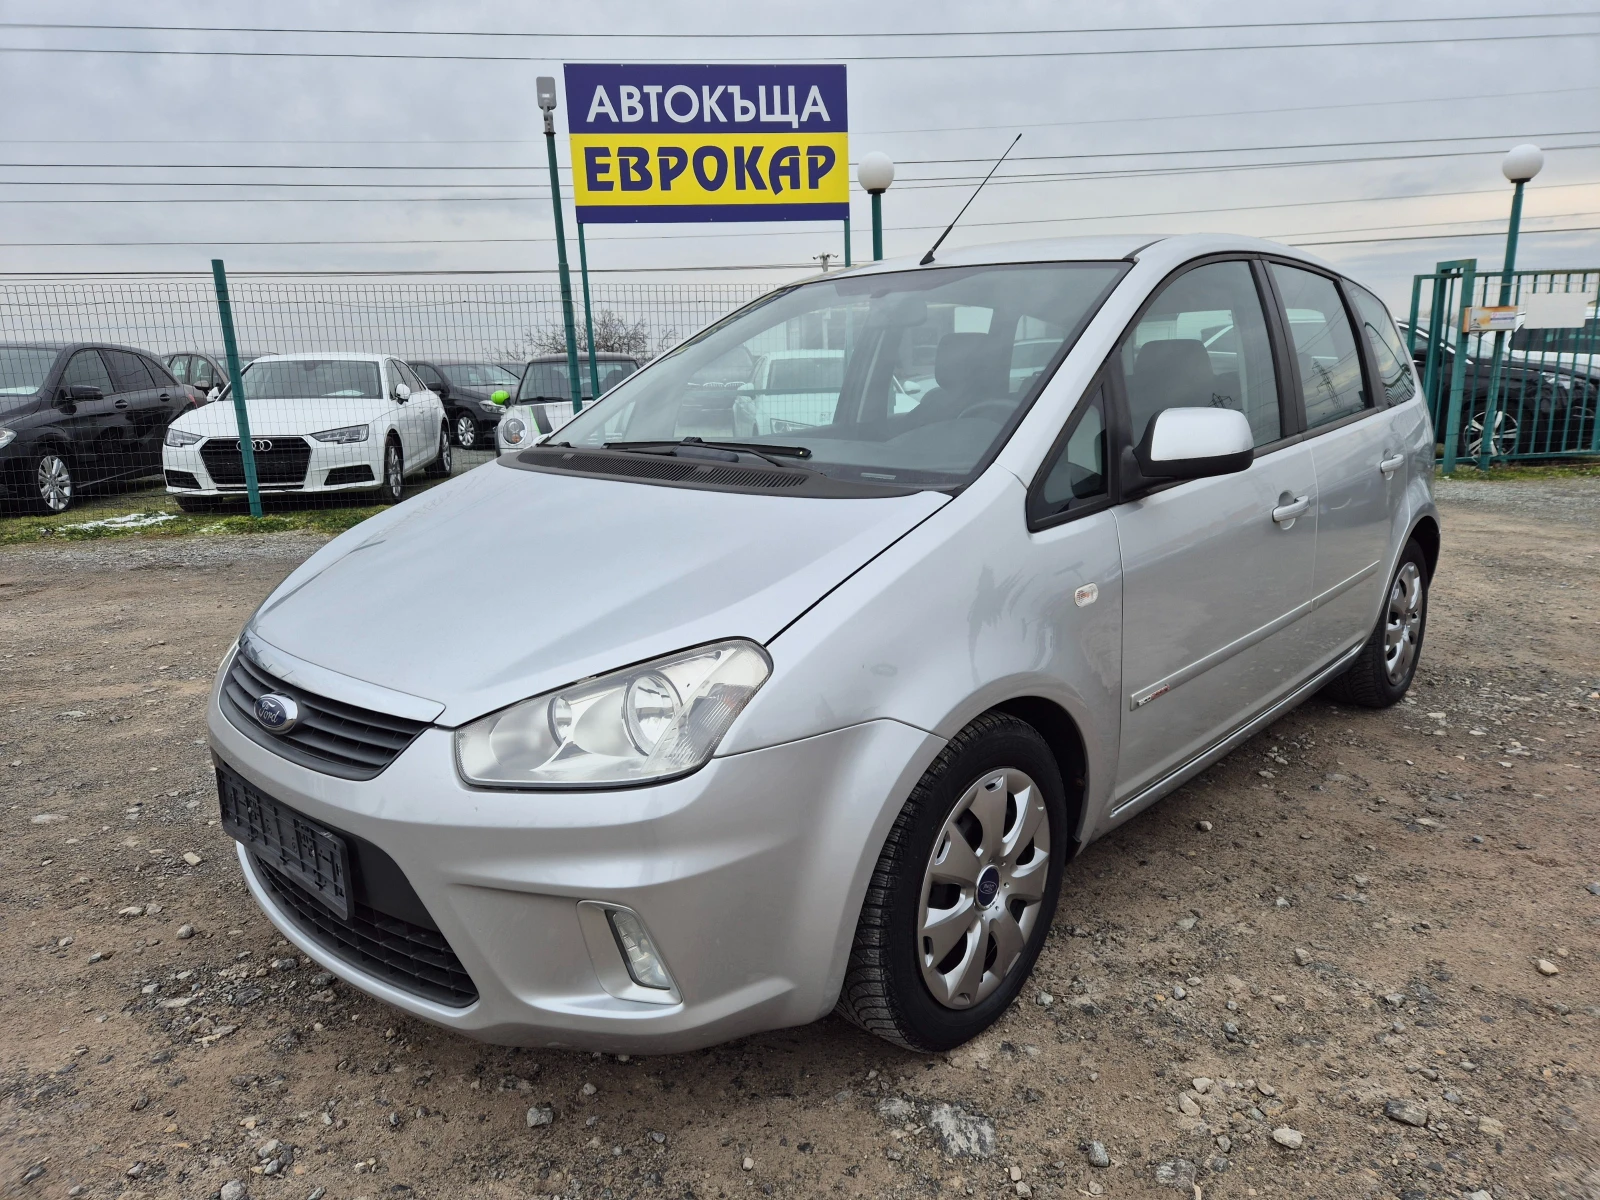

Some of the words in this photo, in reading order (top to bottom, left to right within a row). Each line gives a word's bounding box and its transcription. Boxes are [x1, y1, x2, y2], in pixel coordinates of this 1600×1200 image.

[586, 85, 831, 128] АВТОКЪЩА
[584, 145, 836, 195] ЕВРОКАР
[258, 700, 281, 723] Ford
